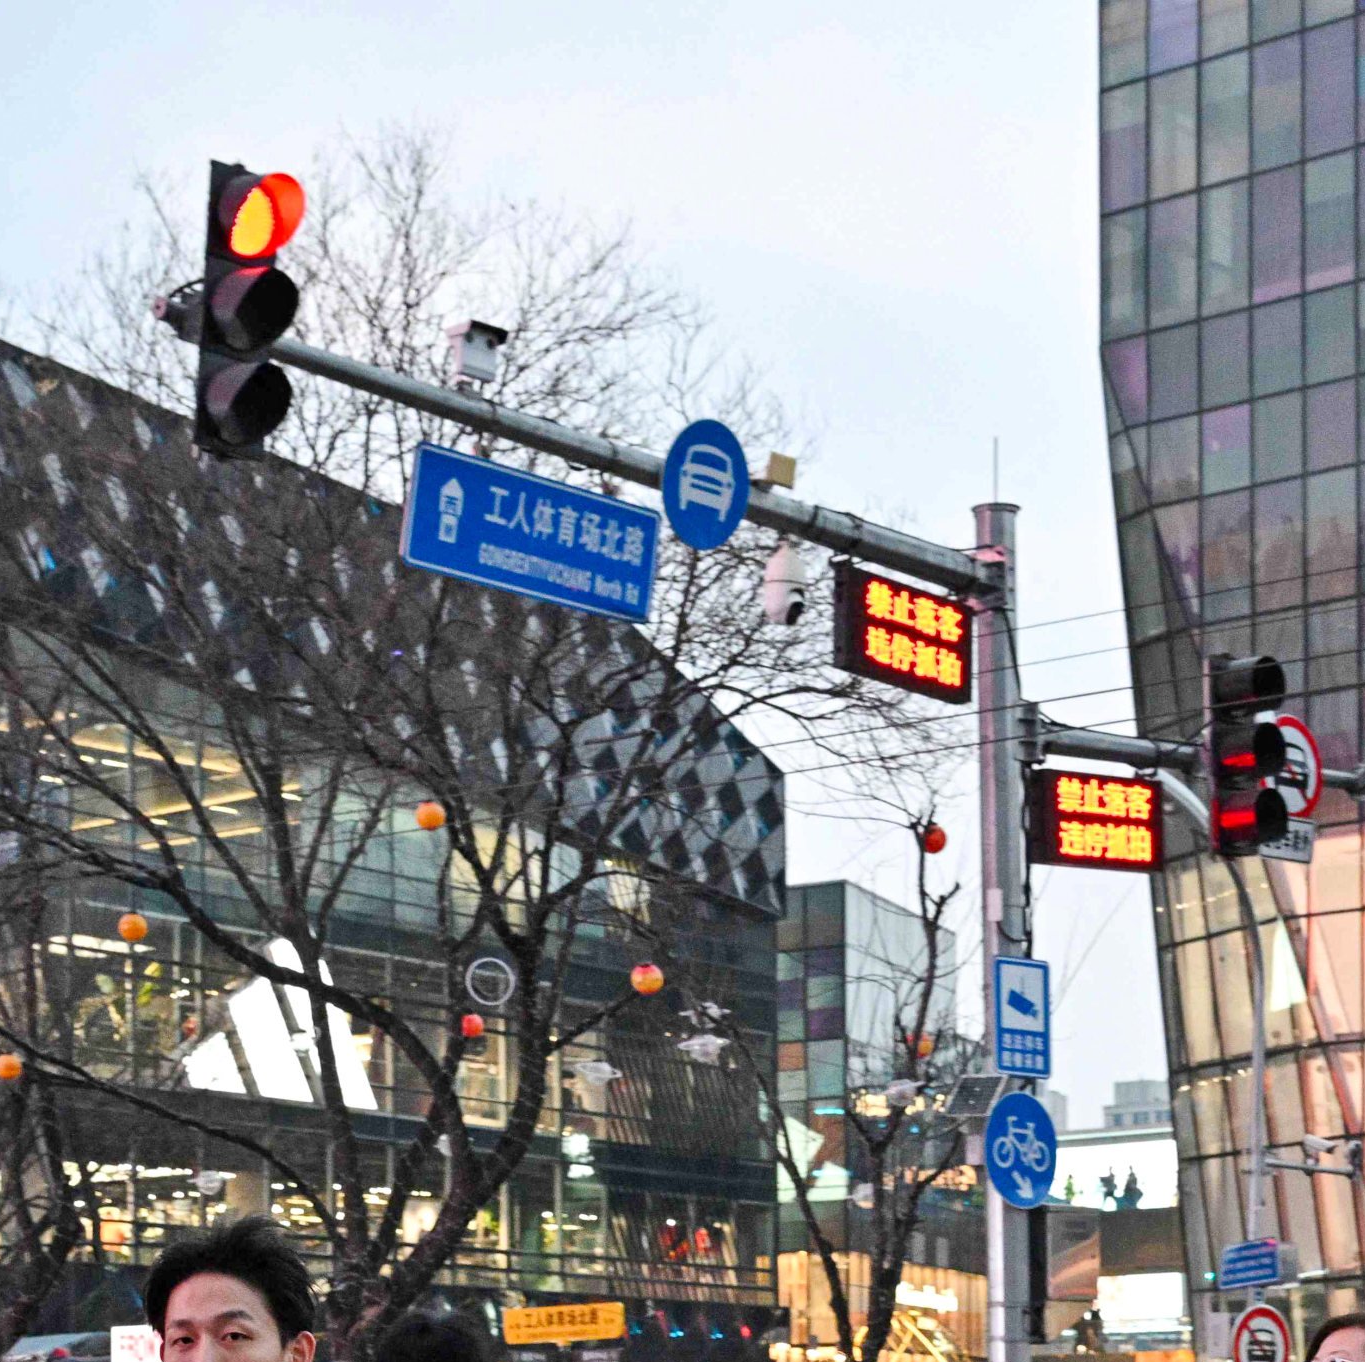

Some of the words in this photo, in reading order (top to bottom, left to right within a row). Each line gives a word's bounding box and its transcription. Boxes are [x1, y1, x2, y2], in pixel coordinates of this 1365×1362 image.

[484, 484, 645, 567] 工人体育场北路
[865, 580, 964, 643] 禁止落客
[865, 625, 963, 688] 违停抓拍
[1056, 776, 1152, 821] 禁止落客
[1058, 820, 1153, 863] 违停抓拍
